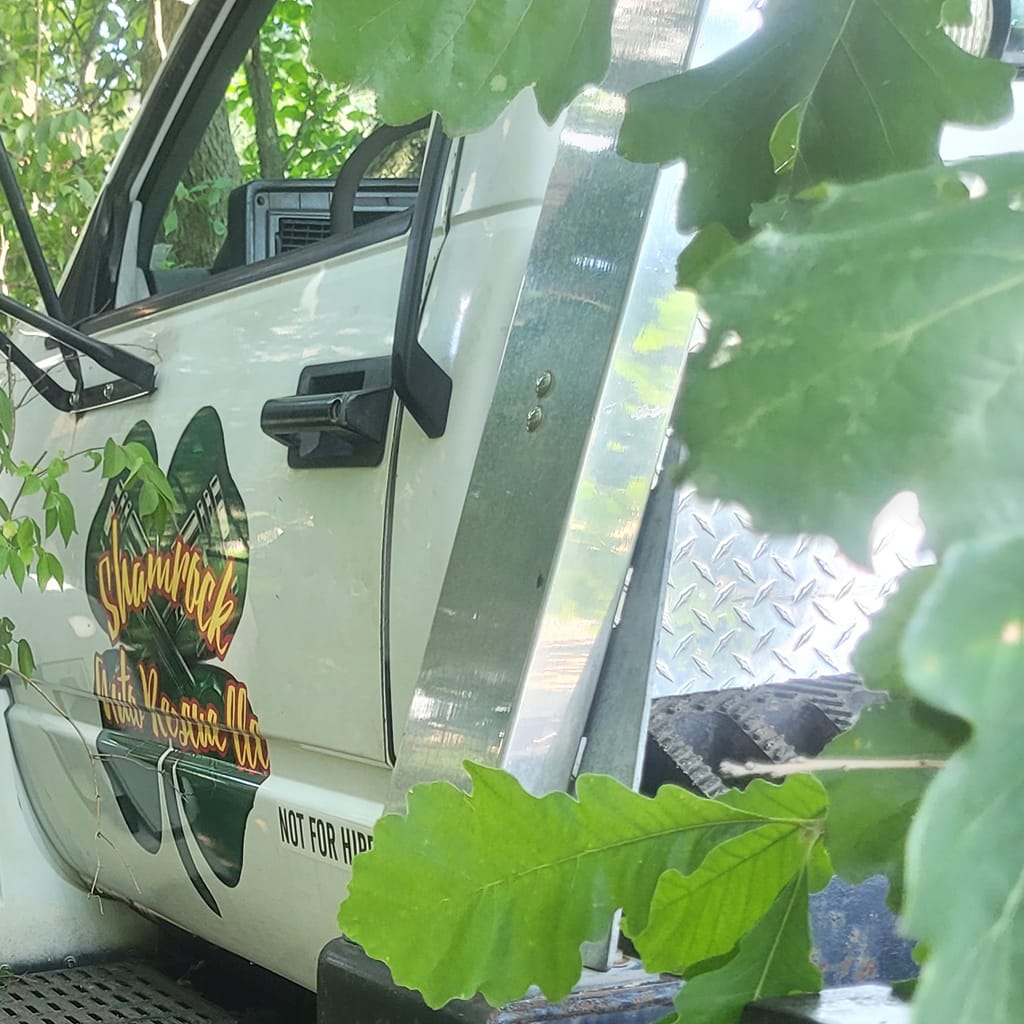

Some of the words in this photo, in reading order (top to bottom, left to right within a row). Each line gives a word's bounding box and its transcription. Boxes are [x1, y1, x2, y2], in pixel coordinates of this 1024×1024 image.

[97, 516, 237, 658] Shamrock
[278, 805, 306, 850] NOT
[309, 817, 338, 862] FOR
